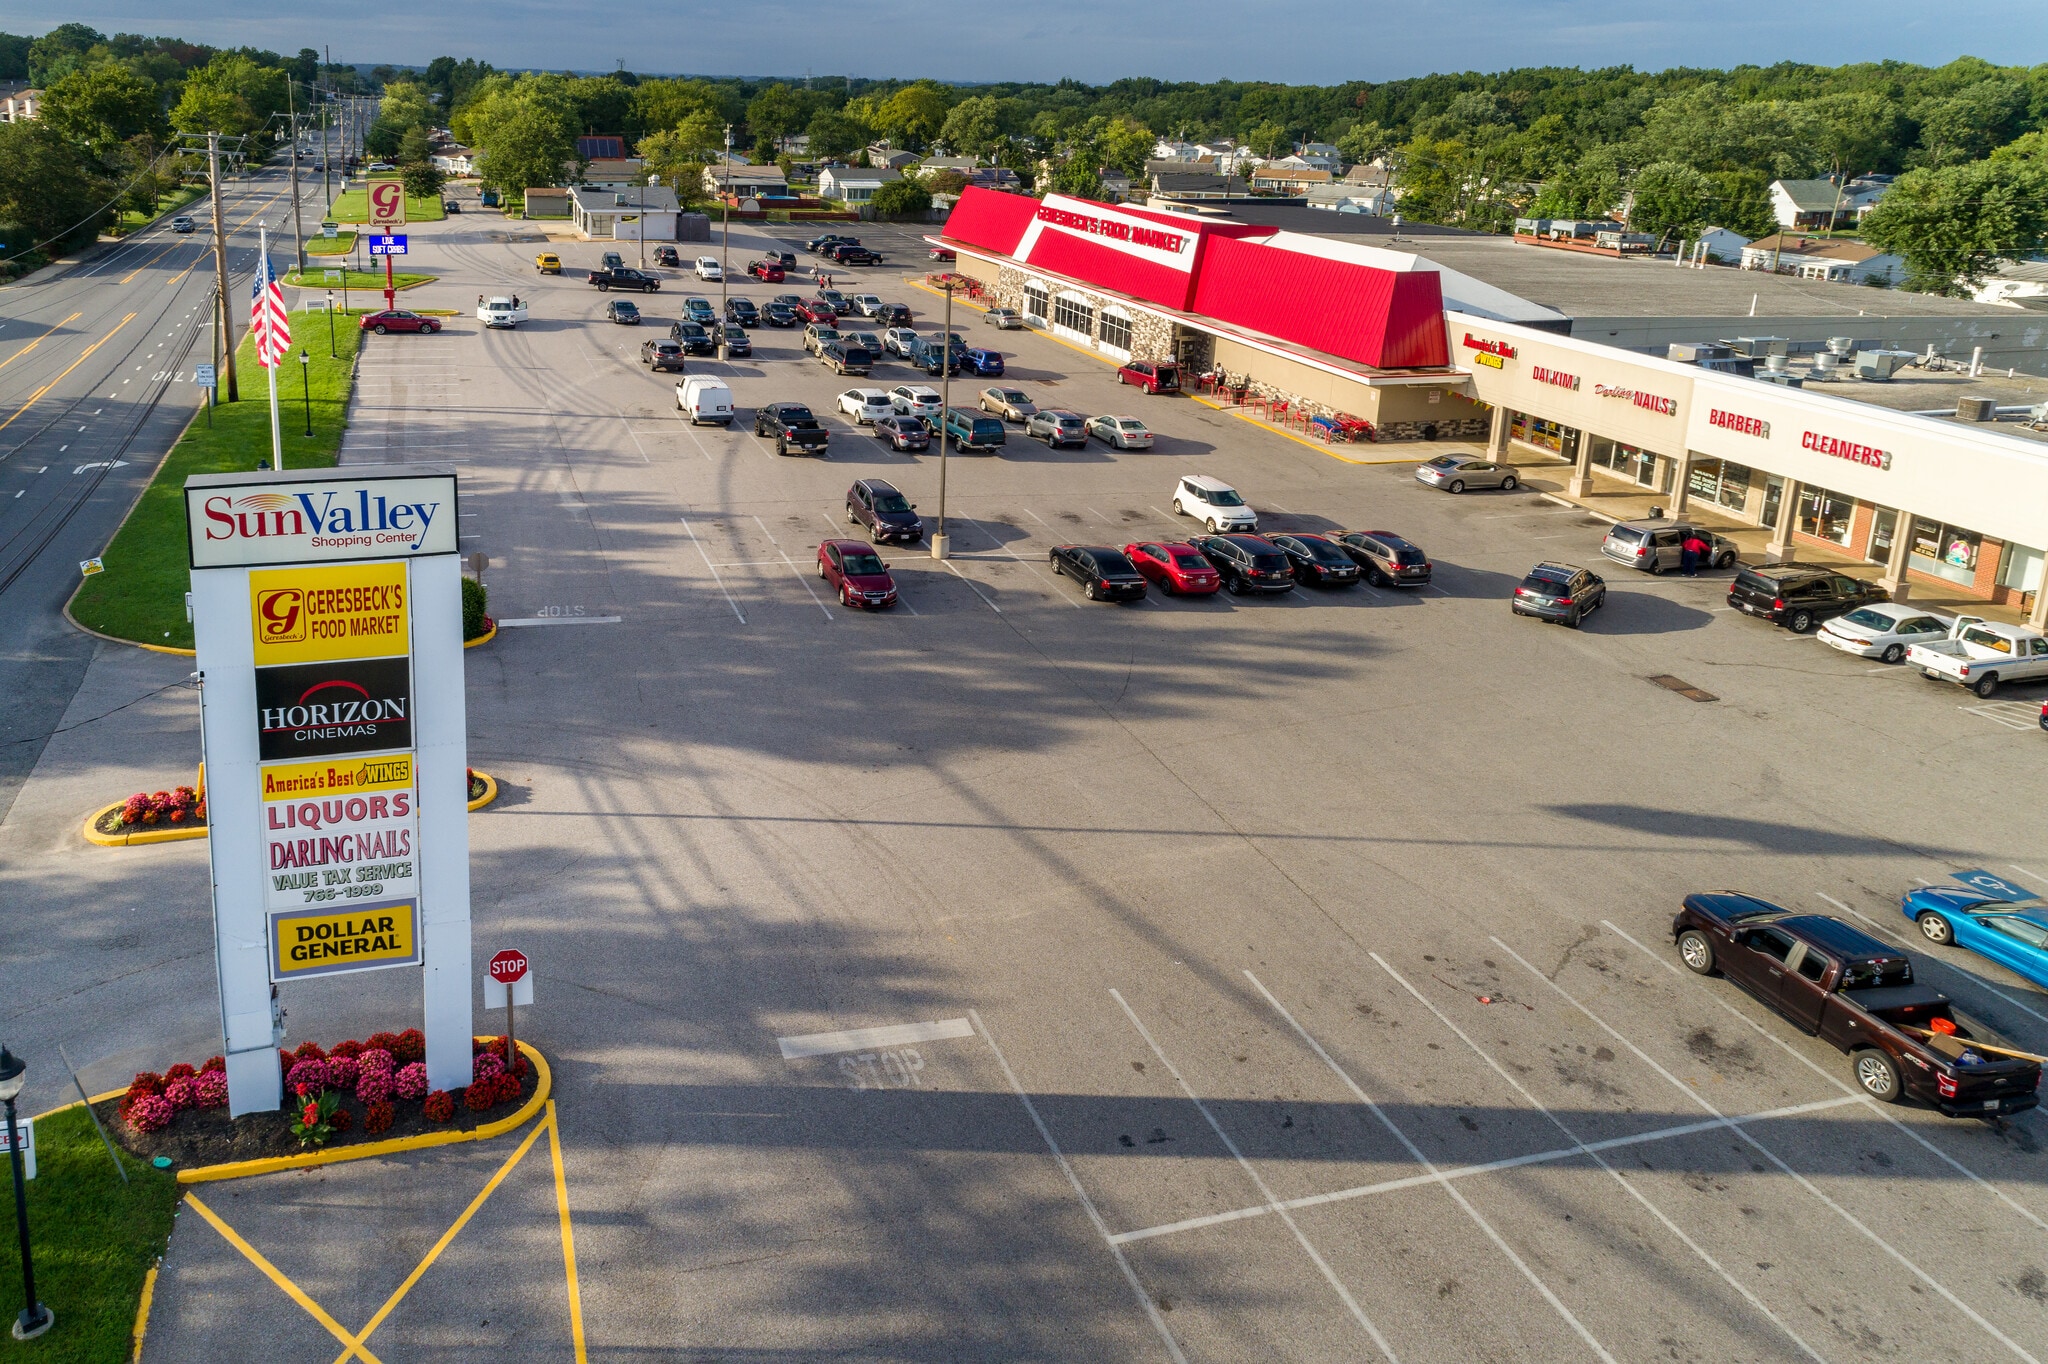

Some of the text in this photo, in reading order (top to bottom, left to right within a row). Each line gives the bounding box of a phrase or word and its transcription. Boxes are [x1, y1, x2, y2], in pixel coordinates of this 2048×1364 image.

[1100, 219, 1130, 242] FOOD
[1132, 226, 1184, 253] MARKET
[1594, 384, 1669, 414] Darling NAILS
[1709, 408, 1763, 437] BARBER
[1802, 431, 1884, 468] CLEANERS
[311, 533, 417, 548] Shopping Center
[306, 584, 402, 615] GERESBECK'S
[311, 615, 400, 640] FOOD MARKET
[262, 698, 406, 729] HORIZON
[294, 725, 377, 741] CINEMAS
[265, 761, 409, 794] America's Best WINGS
[267, 793, 410, 831] LIQUORS
[270, 829, 410, 870] DARLING NAILS
[272, 862, 412, 891] VALUE TAX SERVICE
[303, 883, 383, 903] 766-1999
[296, 916, 395, 943] DOLLAR
[290, 934, 402, 961] GENERAL
[492, 959, 525, 975] STOP
[838, 1049, 925, 1093] STOP
